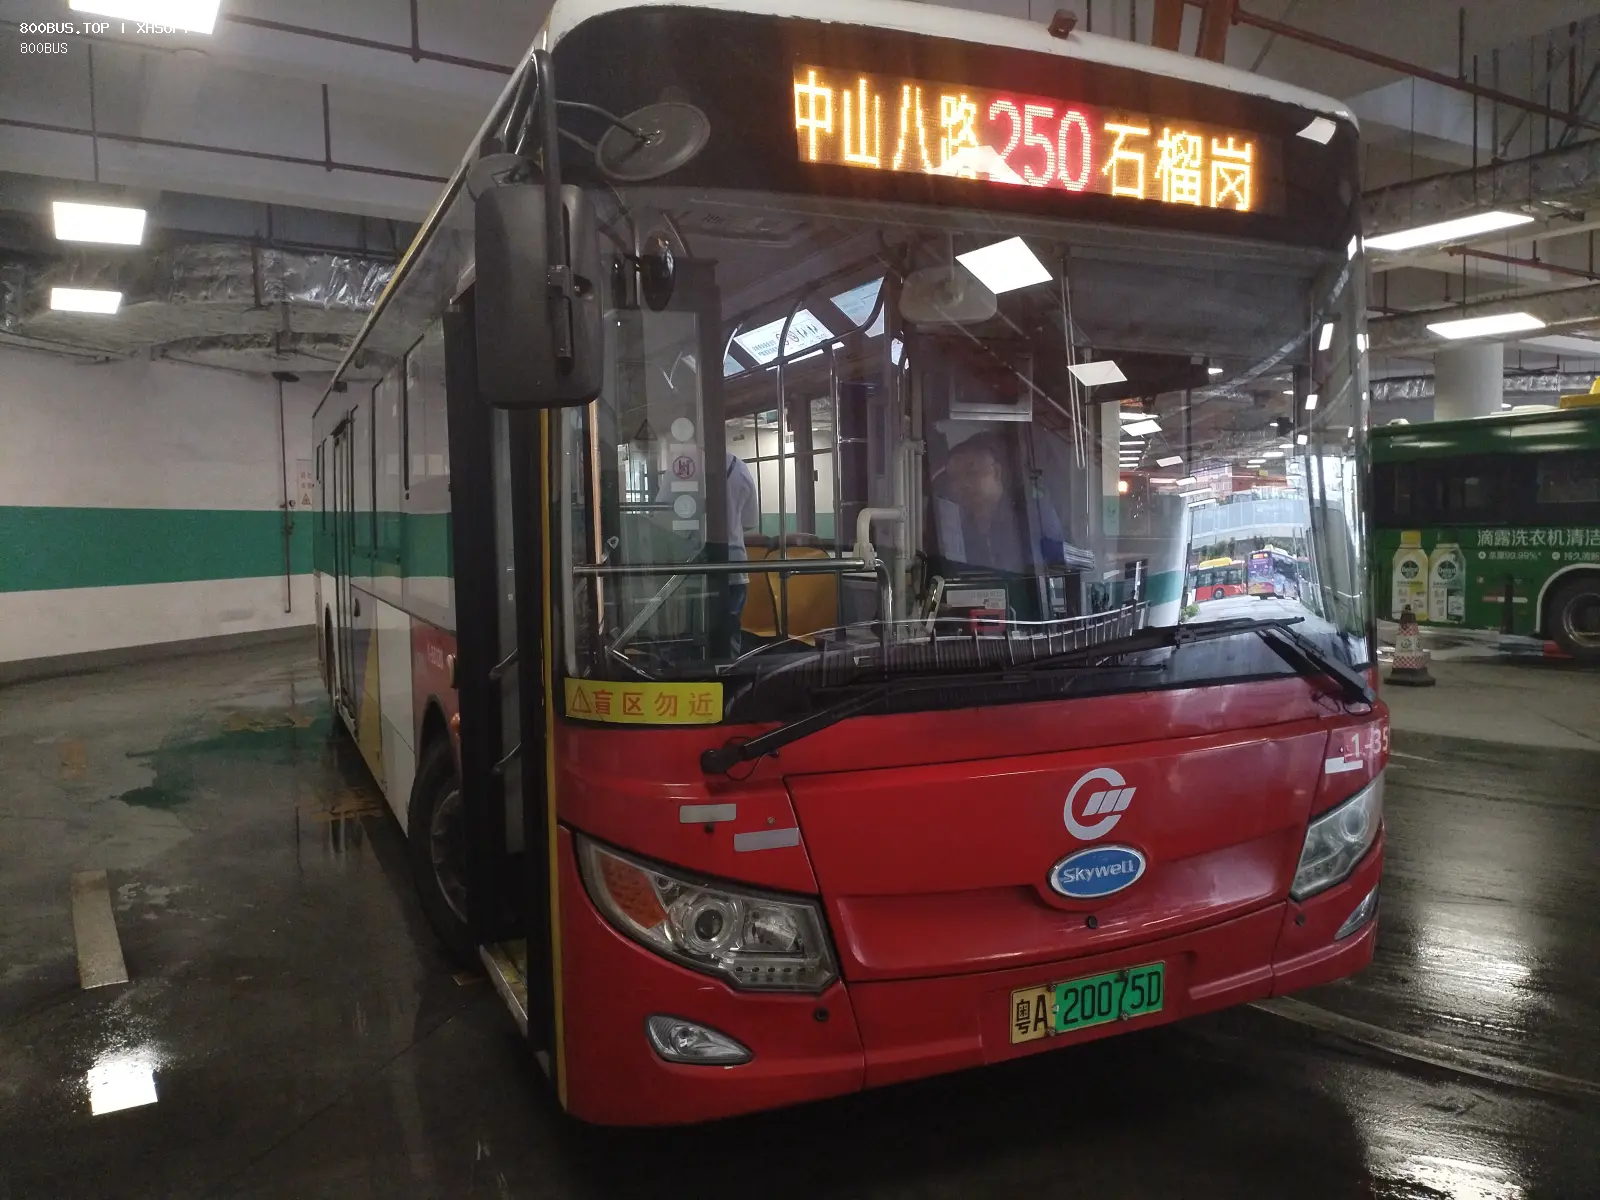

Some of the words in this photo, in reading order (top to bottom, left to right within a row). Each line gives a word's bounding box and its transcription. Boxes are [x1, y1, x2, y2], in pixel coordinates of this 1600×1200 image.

[793, 69, 980, 180] 中山八路
[988, 99, 1092, 192] 250
[1101, 120, 1252, 212] 石榴岗
[592, 689, 714, 718] 盲区勿近
[1062, 859, 1136, 885] Skywell
[1014, 993, 1048, 1034] 粤A
[1063, 970, 1161, 1025] 20075D
